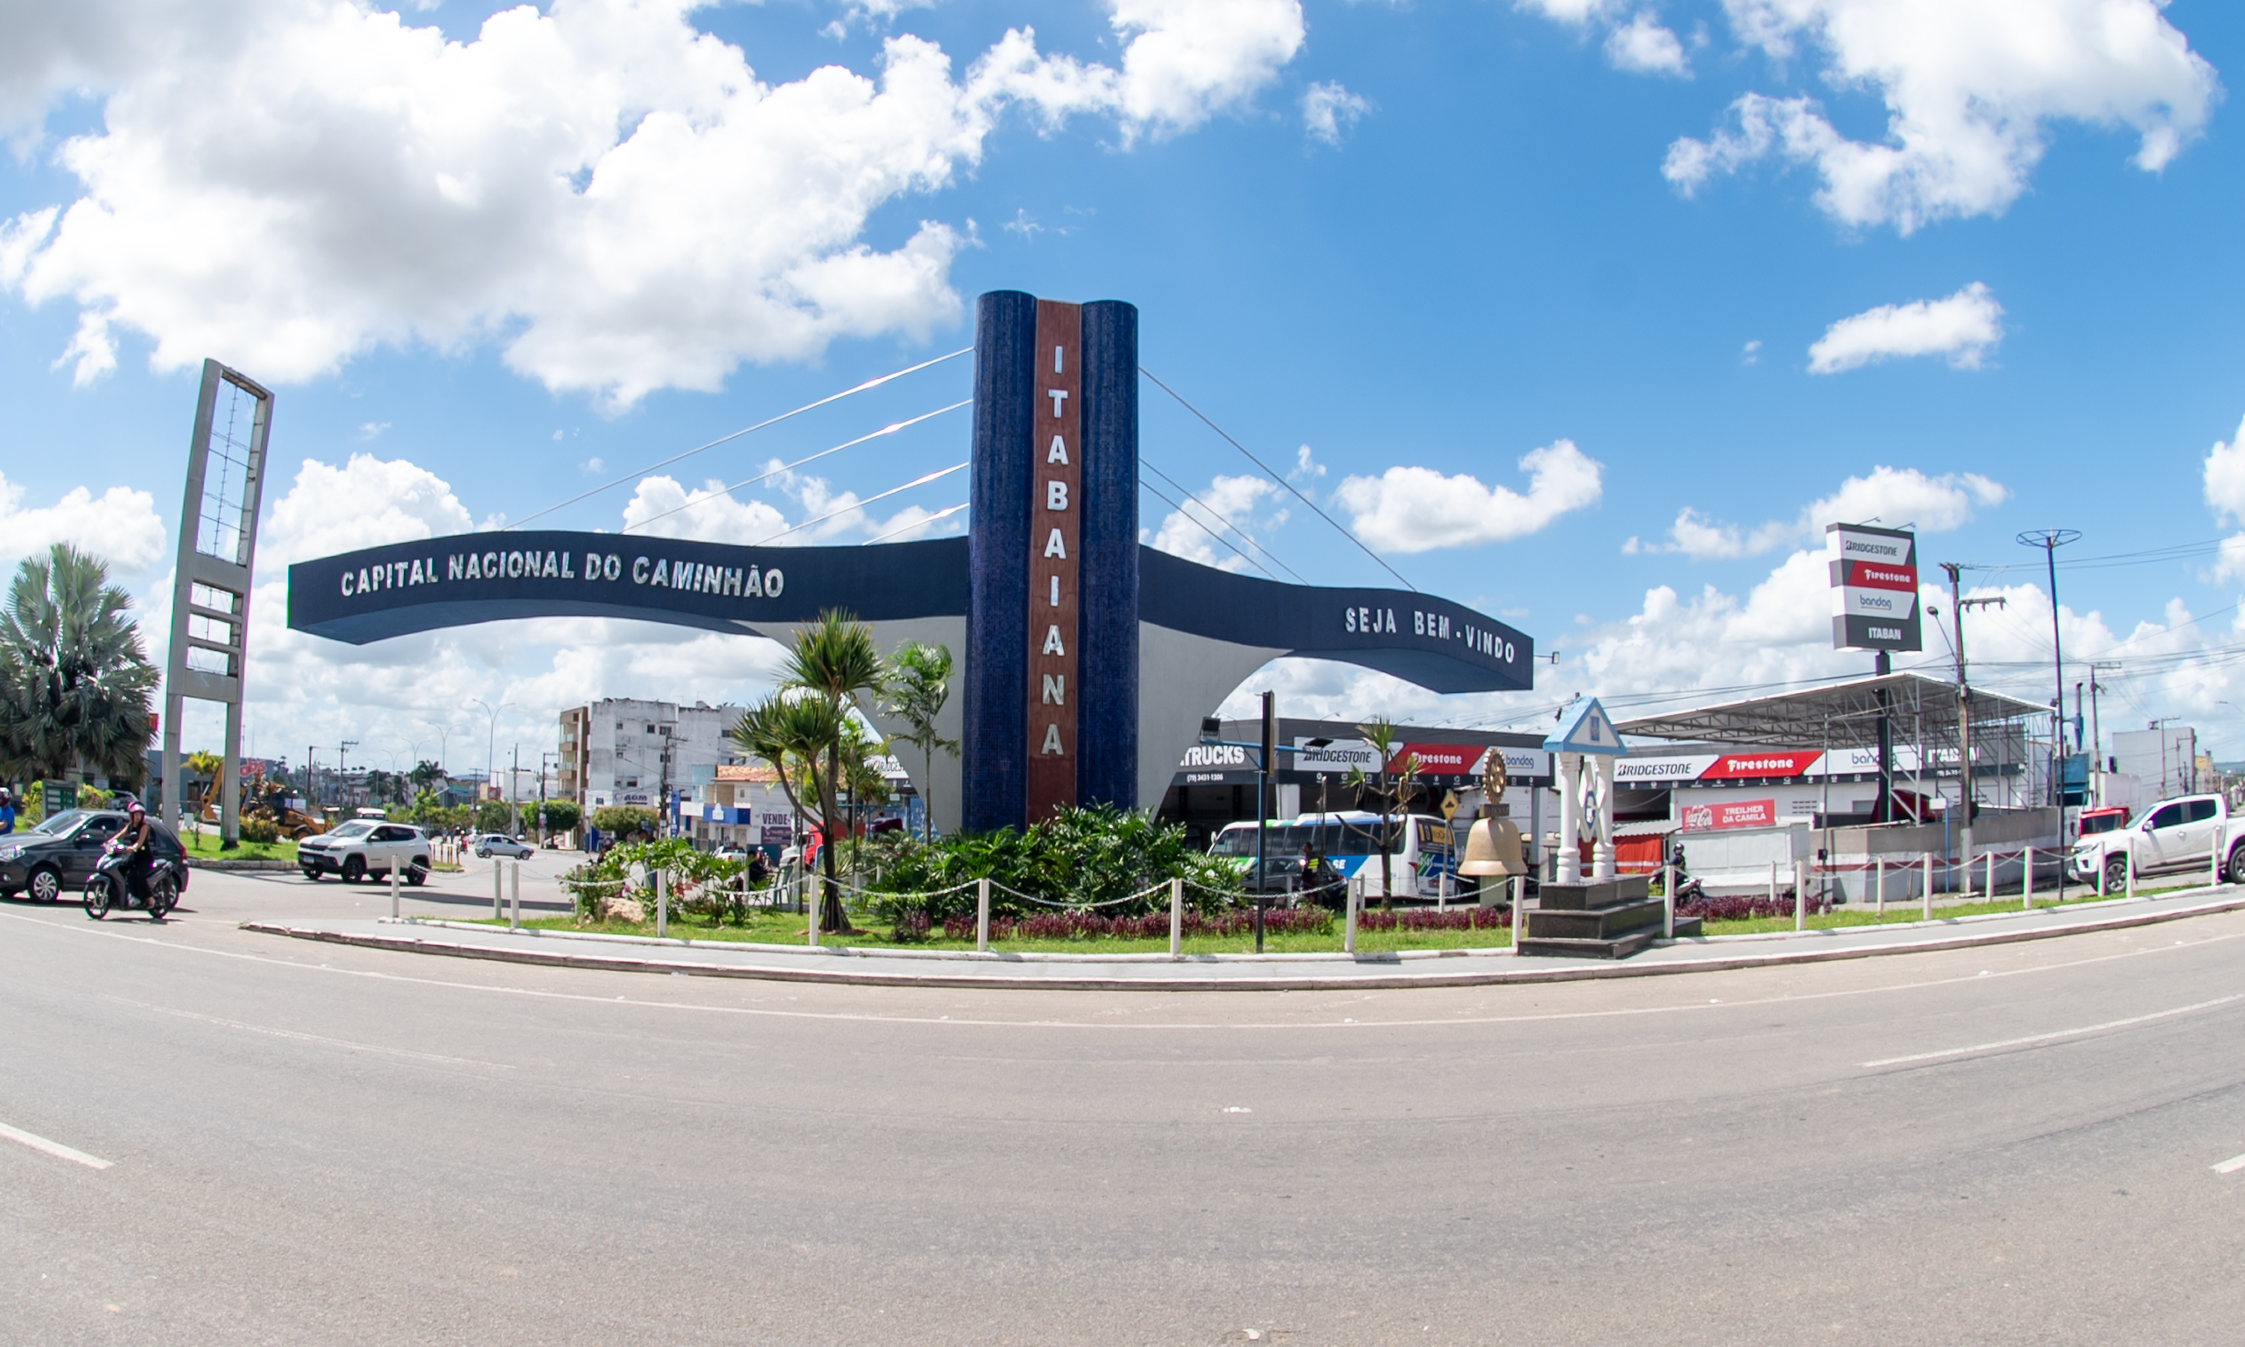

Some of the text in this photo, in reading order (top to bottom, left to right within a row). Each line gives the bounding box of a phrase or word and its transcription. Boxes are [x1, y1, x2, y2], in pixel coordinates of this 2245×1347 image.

[1040, 345, 1069, 756] ITABAIANA
[1845, 540, 1898, 556] BRIDGESTONE
[340, 550, 785, 598] CAPITAL NACIONAL DO CAMINHÃO
[1864, 568, 1911, 583] Firestone
[1860, 595, 1892, 611] bandag
[1345, 606, 1515, 664] SEJA BEM-VINDO
[1868, 627, 1902, 640] ITABAN
[1180, 745, 1246, 767] TRUCKS
[1505, 754, 1535, 769] bandag
[1617, 763, 1692, 777] BRIDGESTONE
[1727, 758, 1795, 773] Firestone
[1722, 813, 1767, 823] DA CAMILA
[1724, 805, 1764, 816] TREILHER
